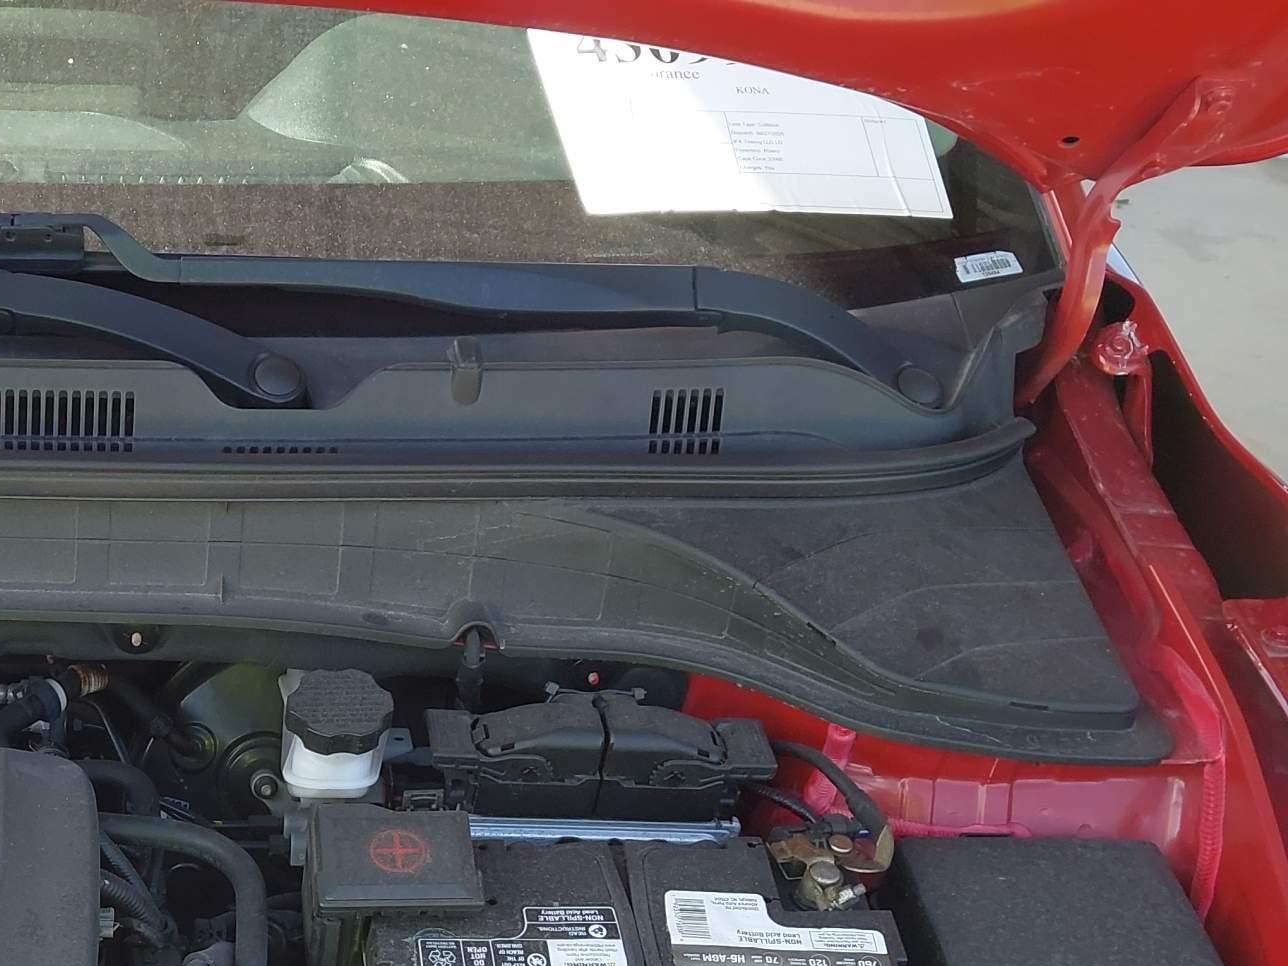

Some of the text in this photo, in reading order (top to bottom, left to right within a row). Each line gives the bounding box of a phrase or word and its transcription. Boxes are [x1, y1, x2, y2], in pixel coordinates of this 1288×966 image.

[735, 85, 770, 96] KONA
[737, 929, 764, 937] Battery
[738, 935, 803, 946] NON-SPILLABLE
[765, 955, 780, 964] 70
[808, 958, 828, 966] 120
